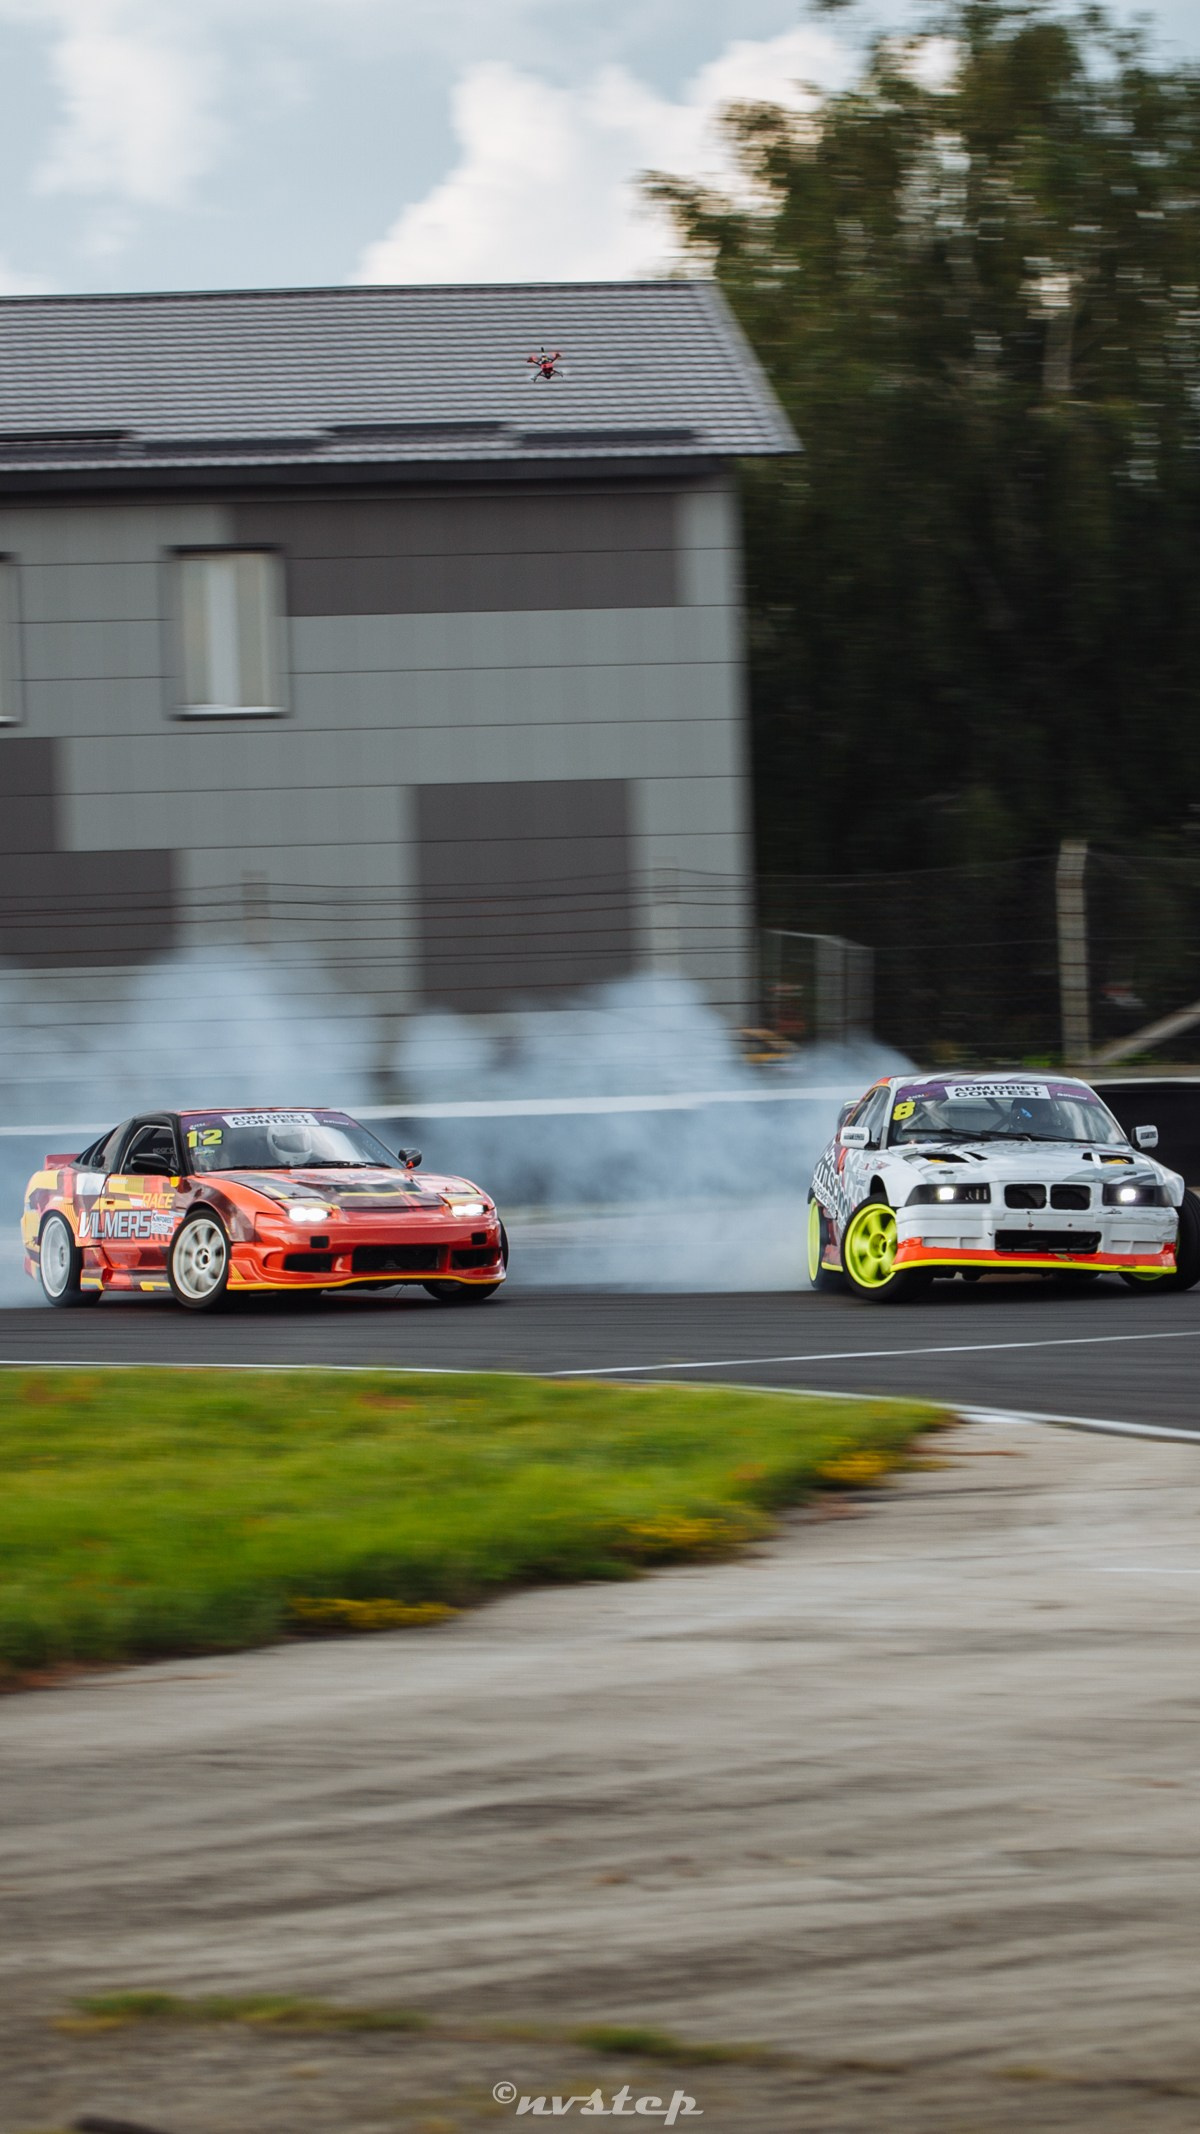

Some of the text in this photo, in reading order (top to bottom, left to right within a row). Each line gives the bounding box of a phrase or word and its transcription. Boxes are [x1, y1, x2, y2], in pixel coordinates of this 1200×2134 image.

[955, 1090, 1043, 1098] CONTEST
[232, 1112, 307, 1122] ADM DRIFT
[892, 1101, 916, 1121] 8
[234, 1118, 311, 1126] CONTEST
[187, 1128, 223, 1148] 12
[143, 1193, 175, 1209] RACE
[79, 1210, 152, 1239] VILMERS
